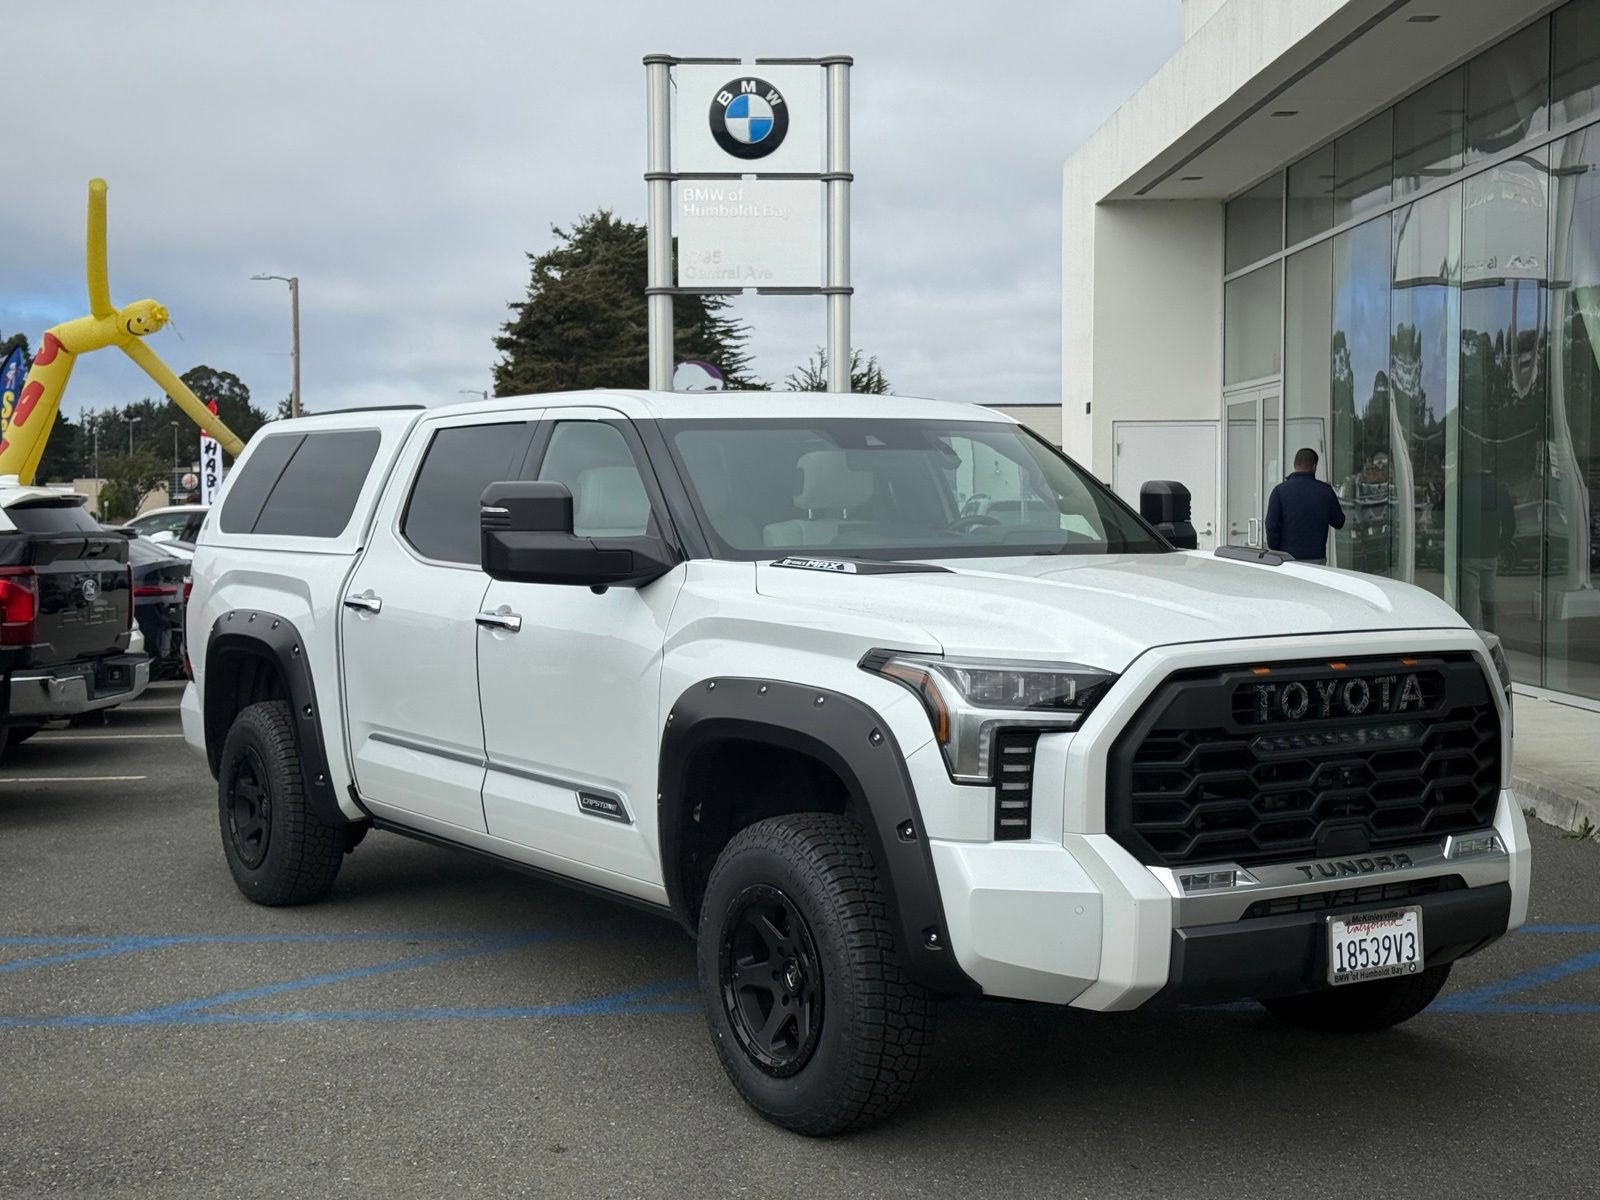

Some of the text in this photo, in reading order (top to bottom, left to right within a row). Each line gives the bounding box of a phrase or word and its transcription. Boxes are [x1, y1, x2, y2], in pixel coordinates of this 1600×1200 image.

[716, 80, 782, 107] BMW
[683, 188, 744, 201] BMW of
[683, 203, 792, 221] Humboldt Bay
[685, 265, 774, 280] Central Ave
[806, 561, 840, 571] MAX
[1253, 672, 1427, 723] TOYOTA
[582, 798, 617, 811] CAPSTONE
[1296, 852, 1415, 880] TUNDRA
[1345, 918, 1403, 935] California
[1336, 932, 1416, 973] 18539V3
[1360, 968, 1390, 981] Humboldt
[1391, 966, 1404, 976] Bay
